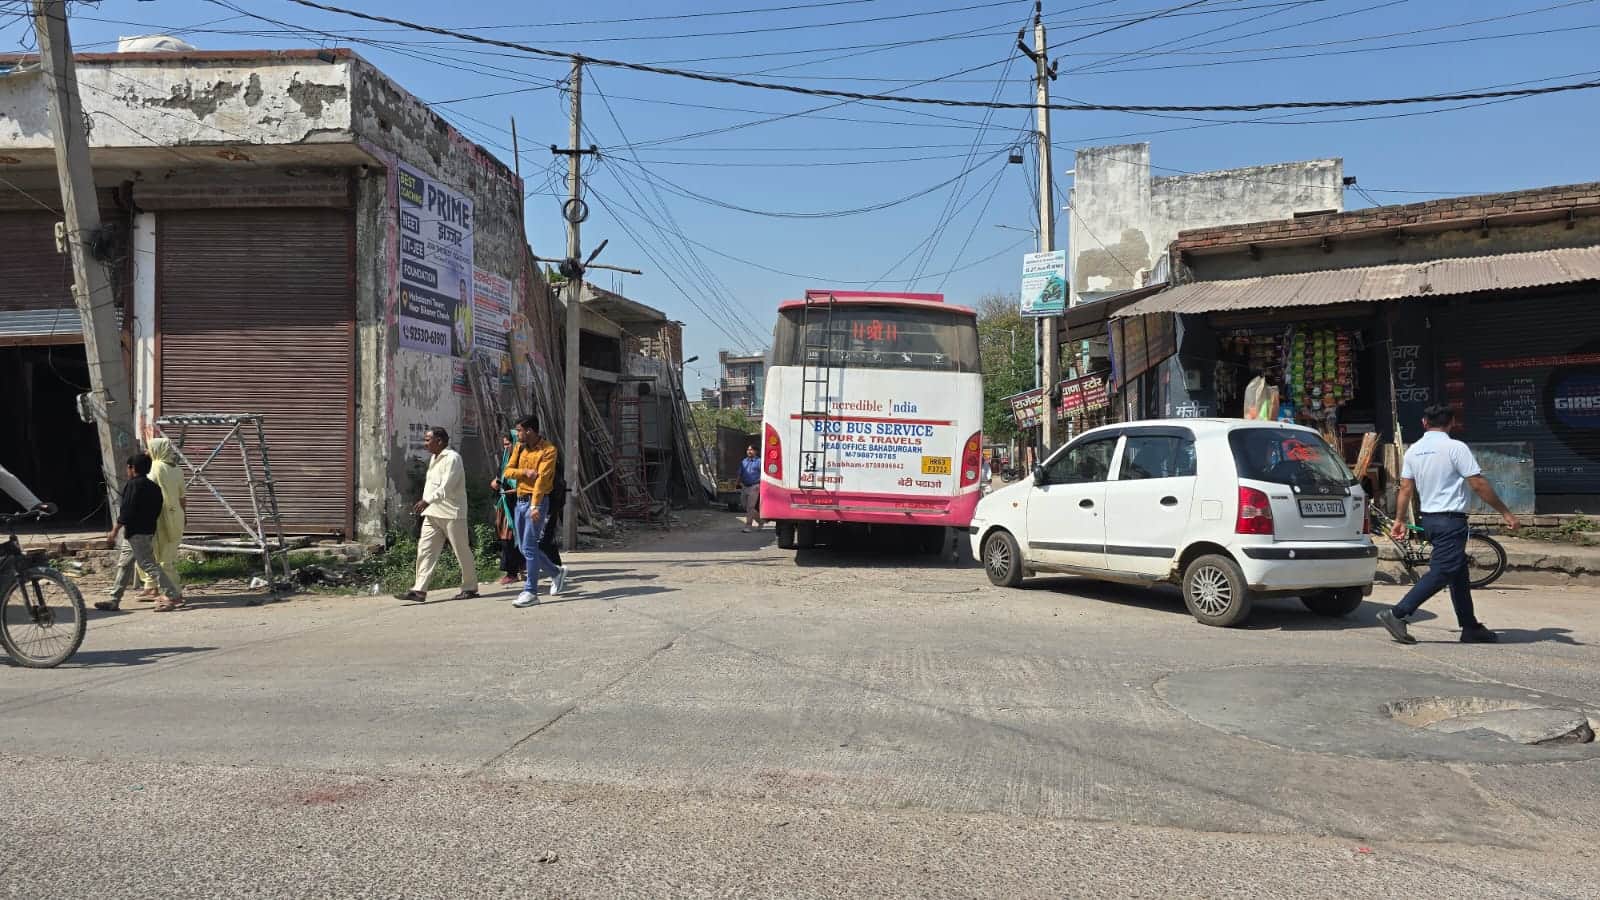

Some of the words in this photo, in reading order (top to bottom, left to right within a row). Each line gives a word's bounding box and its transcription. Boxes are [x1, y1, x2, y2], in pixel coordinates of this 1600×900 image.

[427, 184, 470, 230] PRIME
[402, 213, 419, 233] NEET
[404, 263, 437, 286] FOUNDATION
[1398, 360, 1417, 381] टी
[847, 422, 872, 435] BUS
[876, 423, 934, 438] SERVICE
[821, 442, 841, 451] HEAD
[842, 443, 867, 452] OFFICE
[869, 444, 923, 454] BAHADURGARH
[822, 433, 854, 443] TOUR
[857, 435, 866, 443] &
[870, 435, 922, 446] TRAVELS
[897, 477, 913, 487] बेटी
